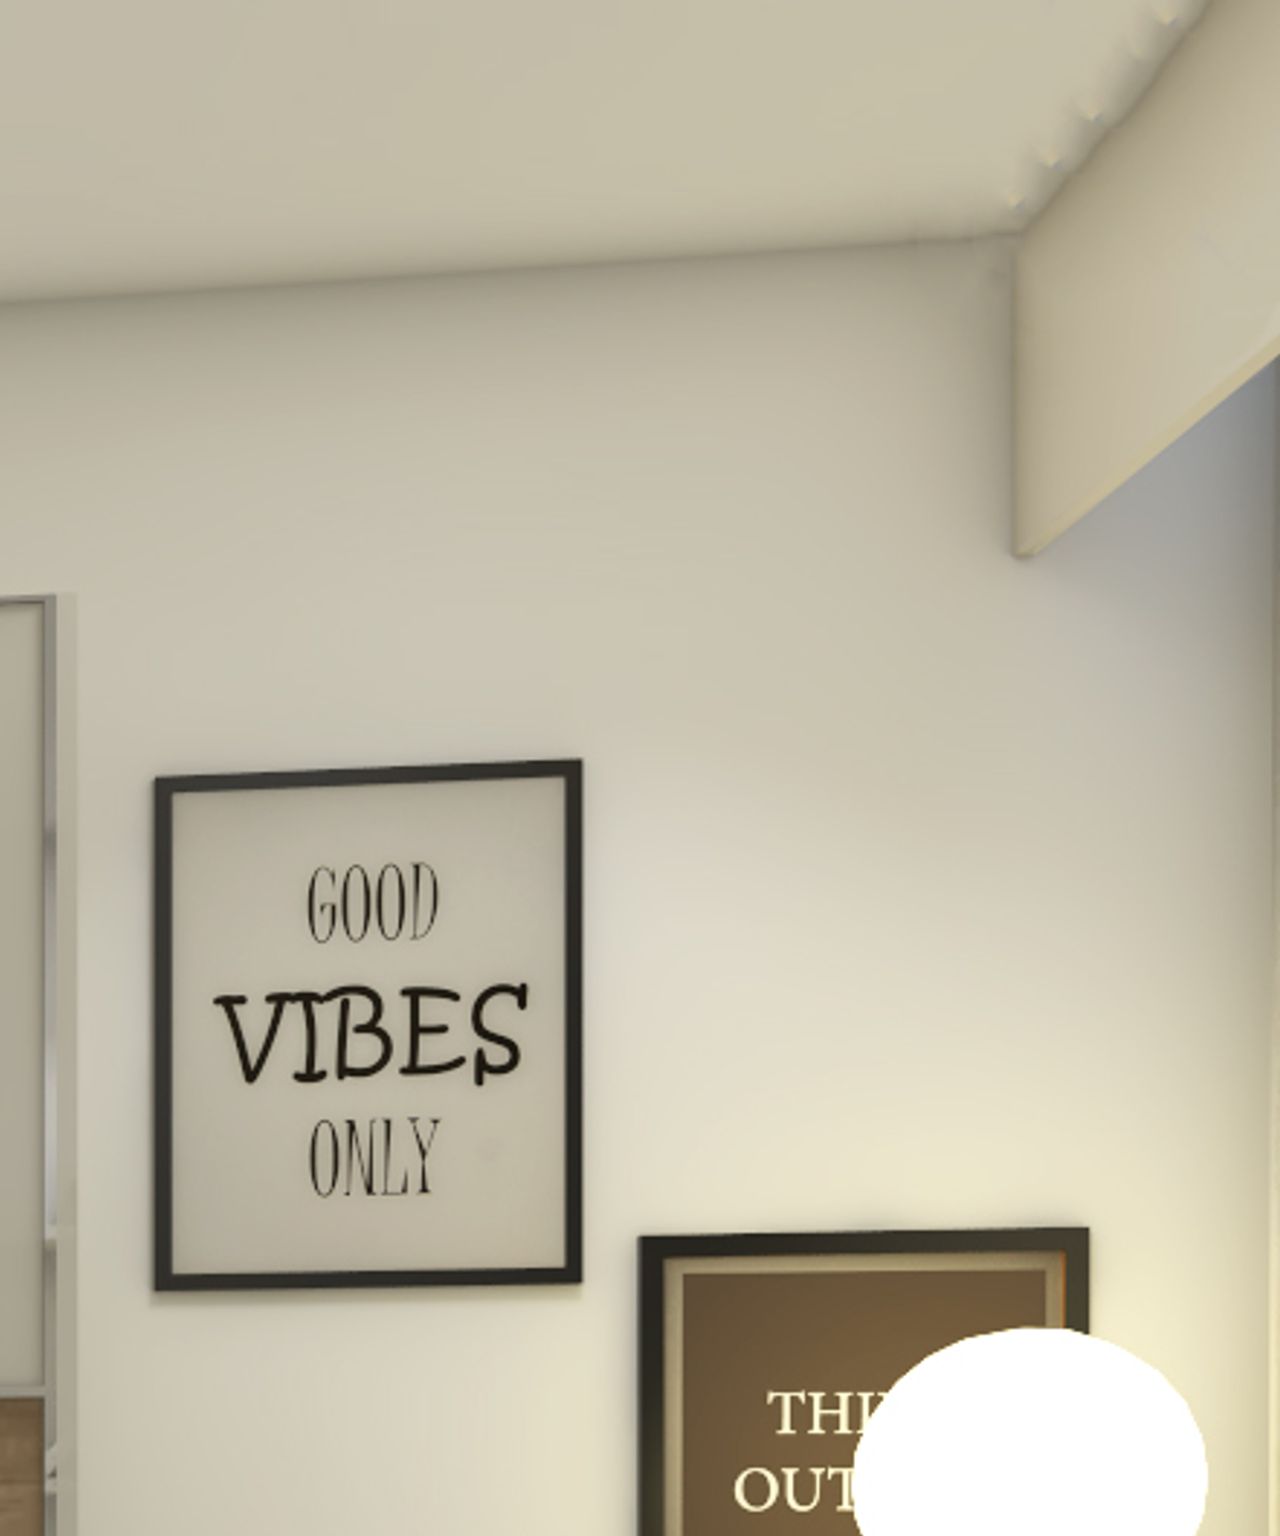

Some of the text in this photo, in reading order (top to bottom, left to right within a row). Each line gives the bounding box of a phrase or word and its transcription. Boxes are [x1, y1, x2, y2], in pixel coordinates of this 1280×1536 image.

[307, 863, 439, 944] GOOD
[212, 982, 529, 1087] VIBES
[309, 1116, 440, 1198] ONLY
[766, 1390, 892, 1435] THI
[733, 1466, 856, 1513] OUT
